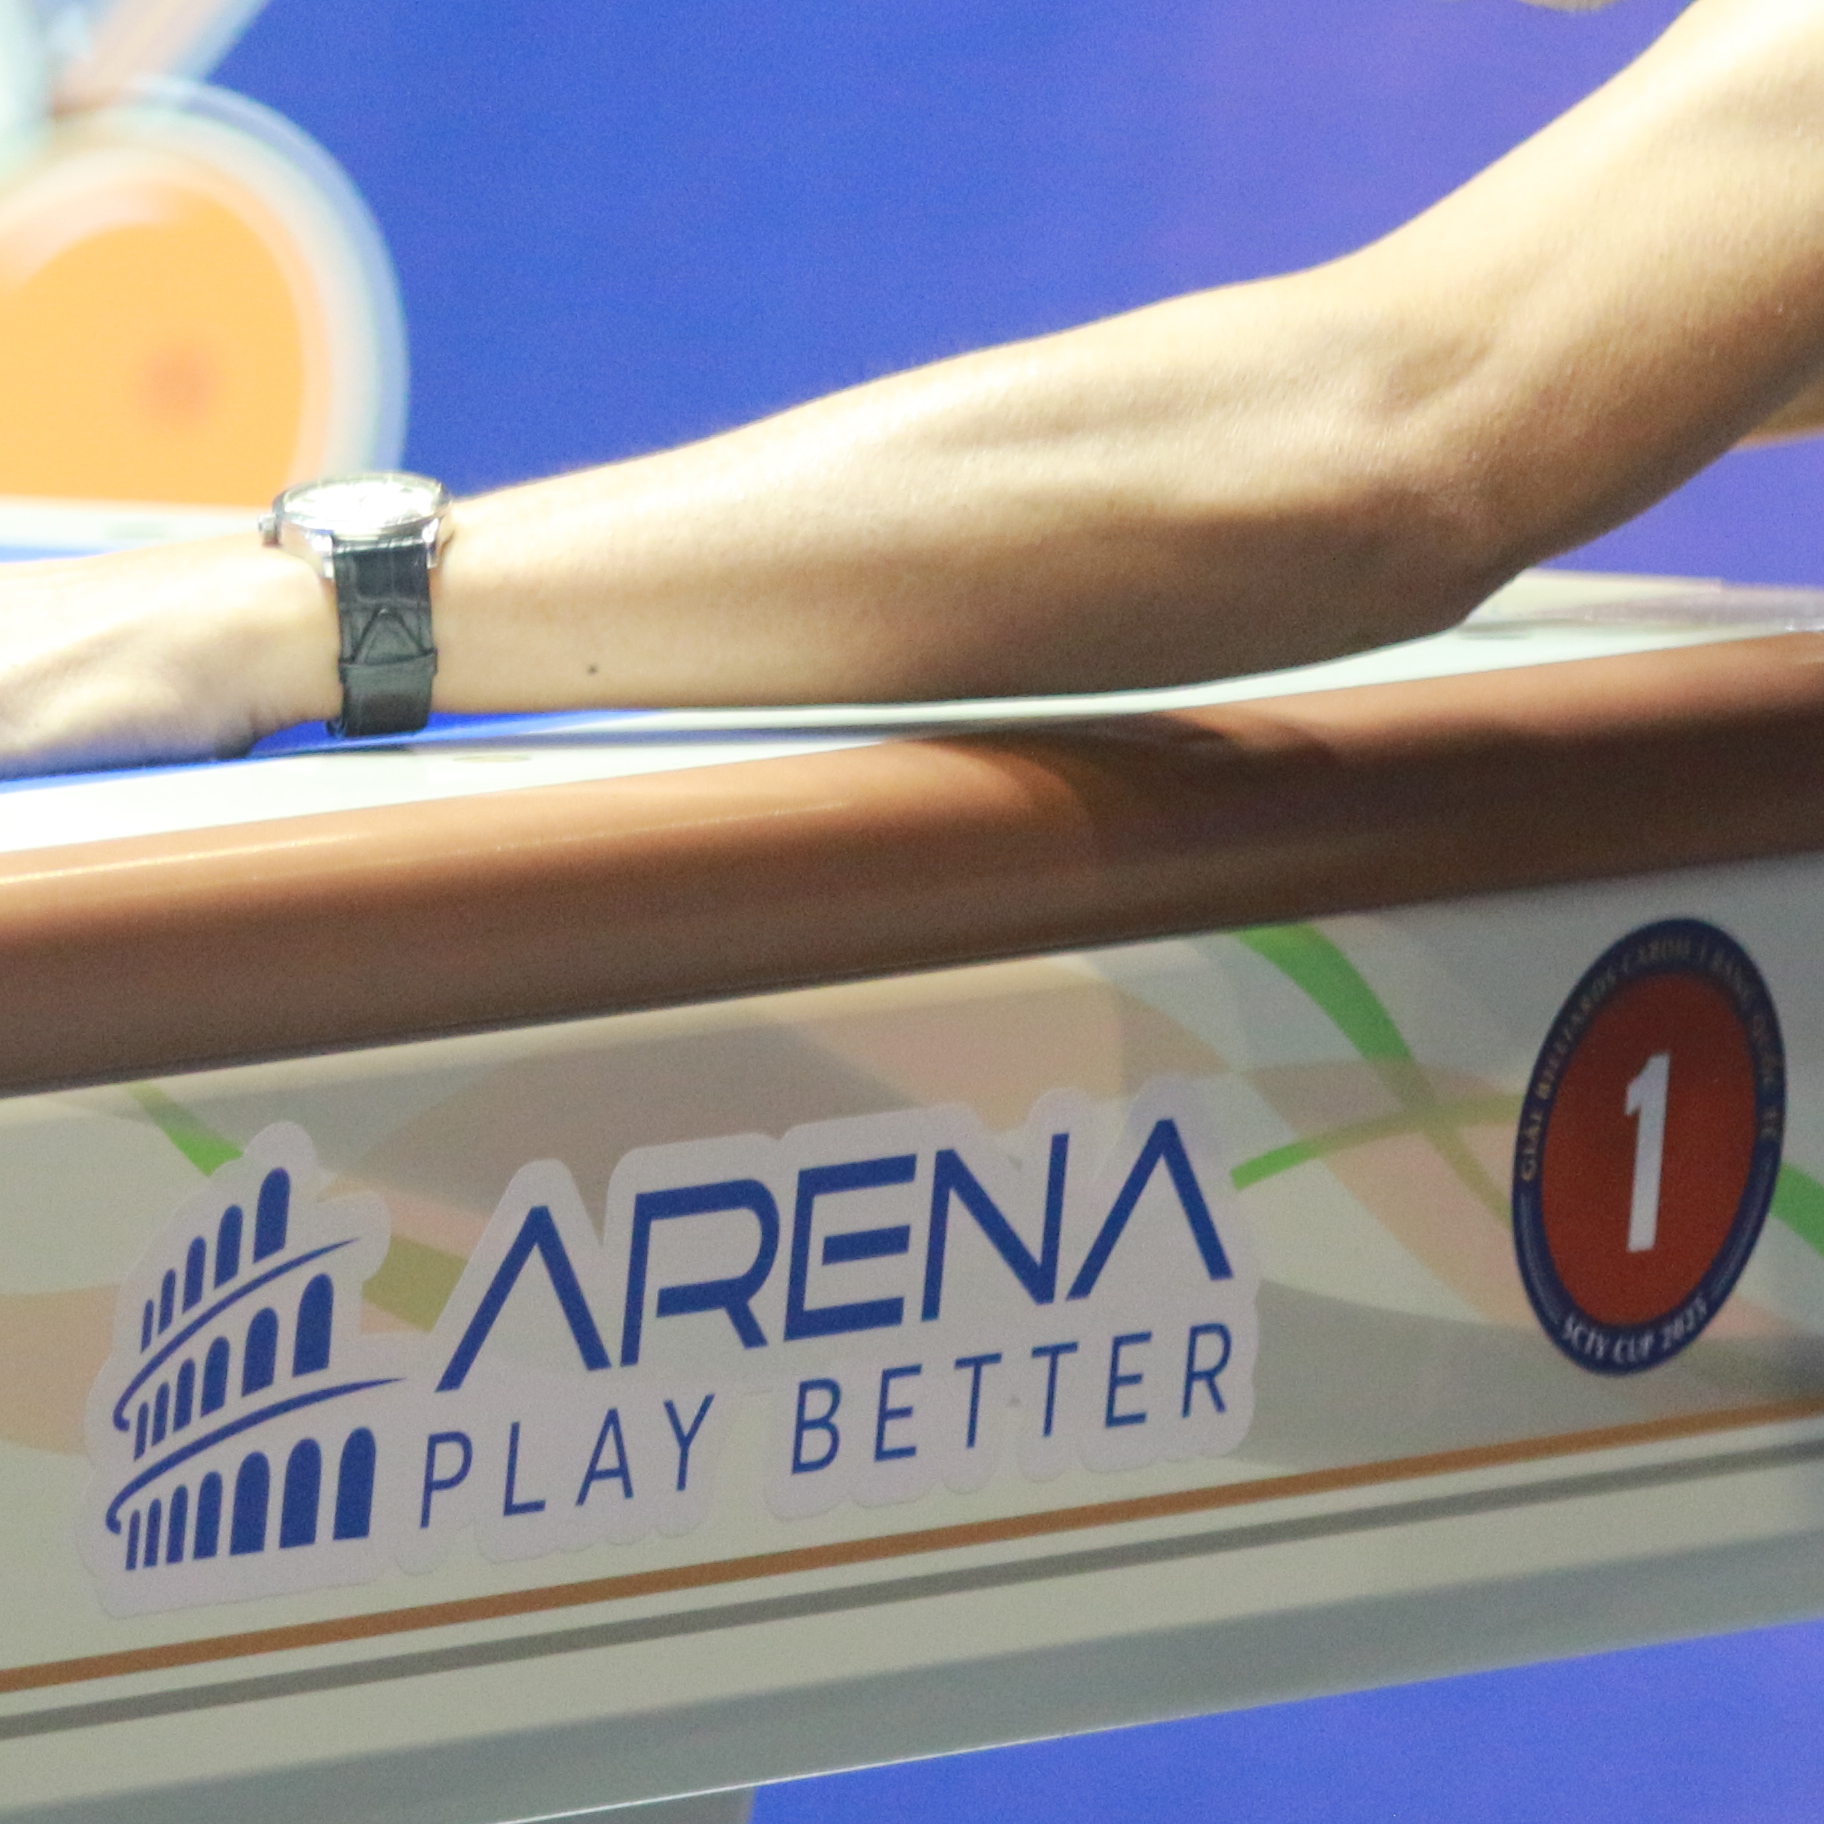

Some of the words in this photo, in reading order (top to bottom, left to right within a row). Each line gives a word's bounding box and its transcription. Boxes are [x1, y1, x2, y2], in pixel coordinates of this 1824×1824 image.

[434, 1118, 1234, 1393] ARENA
[1624, 1051, 1672, 1253] 1
[418, 1394, 715, 1529] PLAY
[790, 1321, 1235, 1475] BETTER
